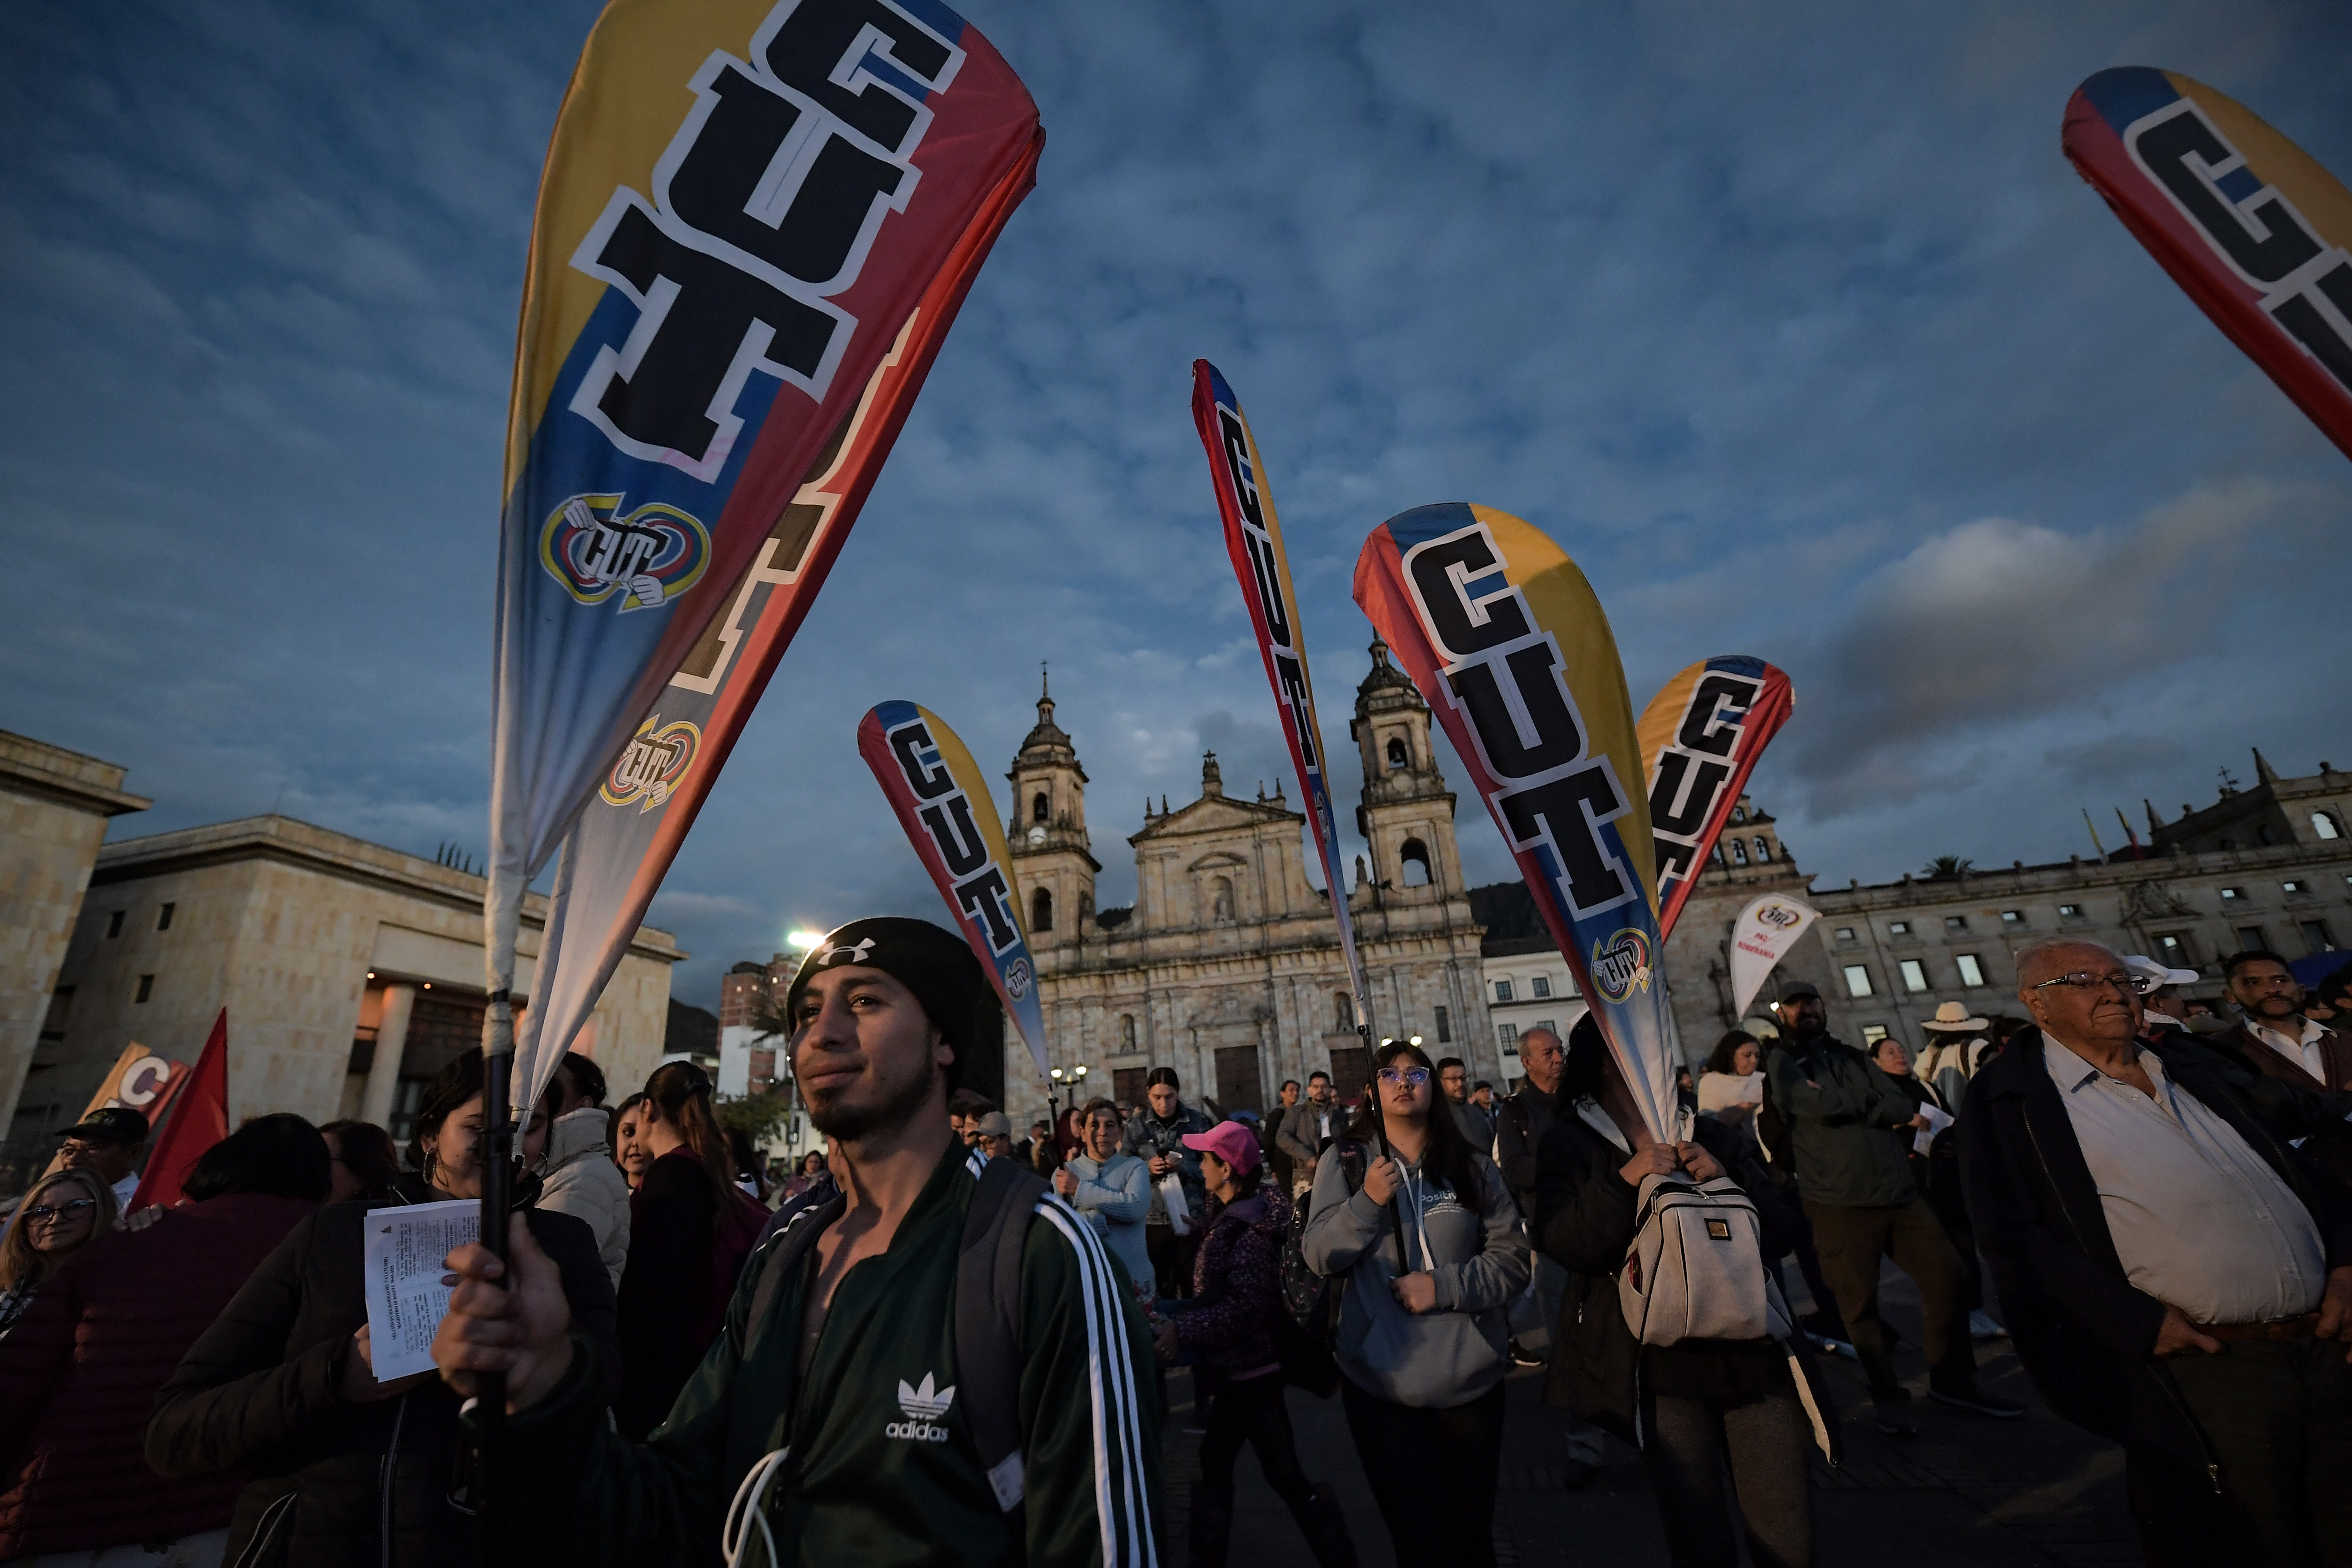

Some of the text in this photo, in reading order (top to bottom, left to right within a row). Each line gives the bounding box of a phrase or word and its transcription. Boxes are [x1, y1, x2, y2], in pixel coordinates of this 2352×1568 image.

[568, 0, 967, 484] CUT
[580, 523, 662, 583] CUT
[1216, 401, 1319, 774] CUT
[621, 741, 676, 787] CUT
[1402, 522, 1638, 922] CUT
[886, 717, 1021, 956] CUT
[1603, 946, 1637, 986] CUT
[885, 1420, 949, 1442] adidas
